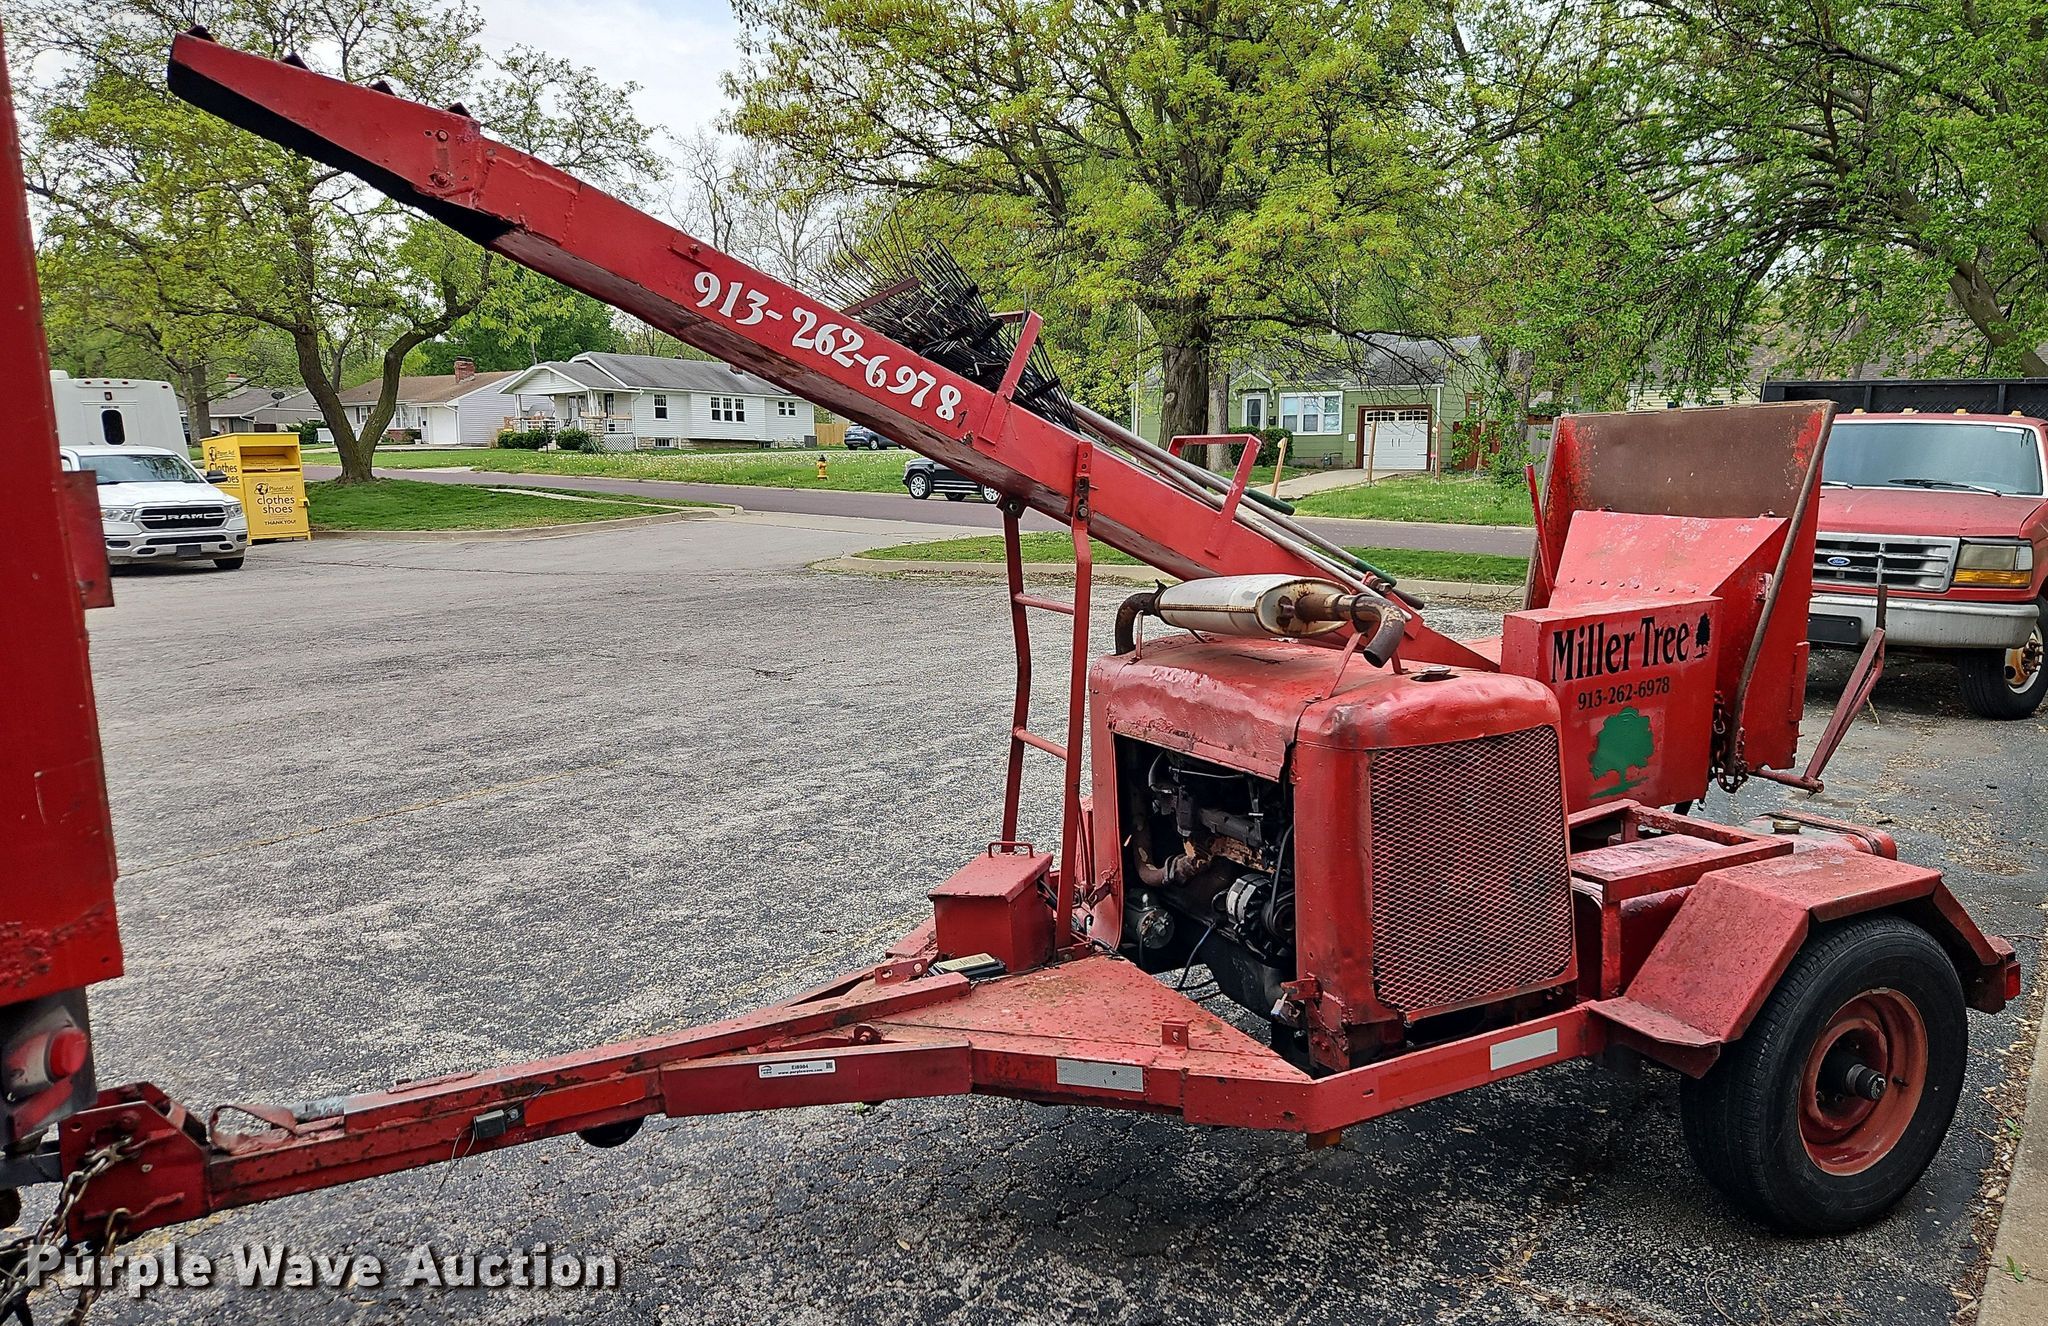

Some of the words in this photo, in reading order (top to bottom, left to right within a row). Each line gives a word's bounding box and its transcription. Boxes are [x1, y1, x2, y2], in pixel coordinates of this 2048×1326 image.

[257, 495, 295, 505] clothes
[262, 504, 293, 514] shoes
[1551, 622, 1636, 683] Miller
[1640, 616, 1690, 667] Tree
[1577, 676, 1670, 711] 913-262-6978
